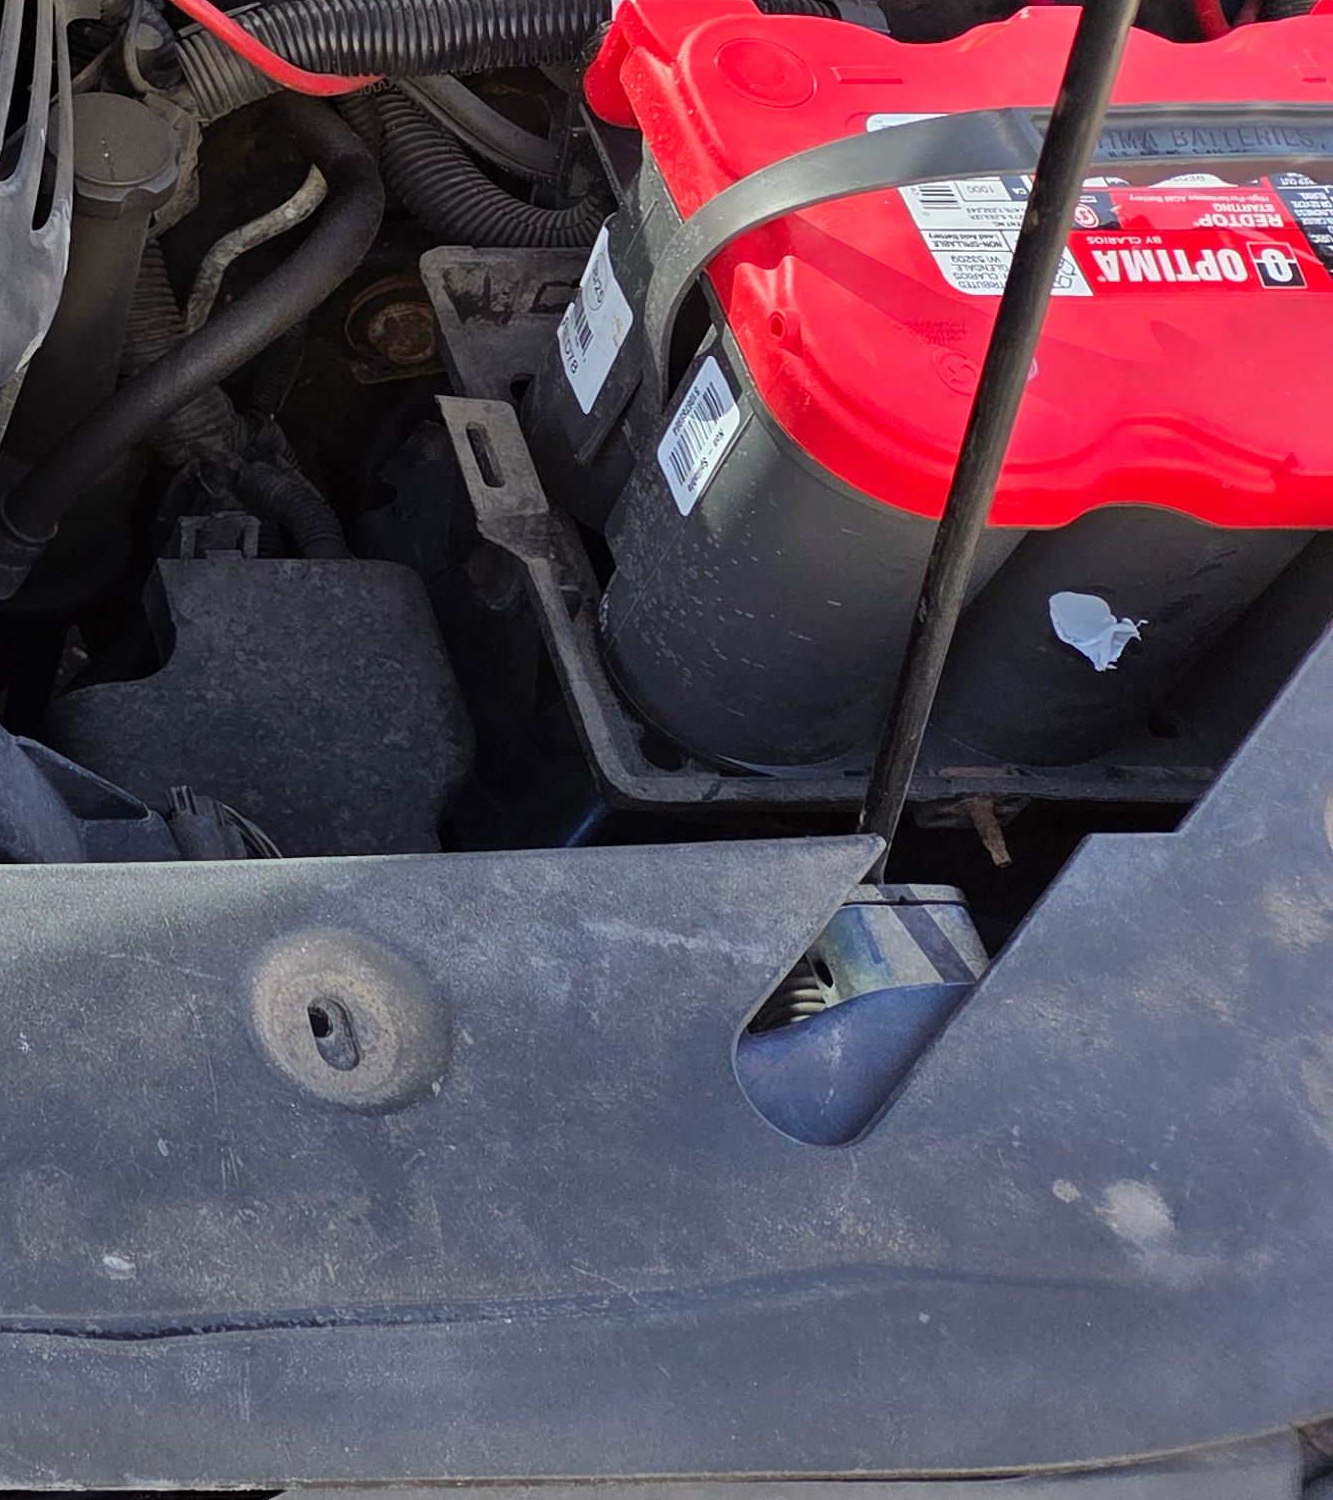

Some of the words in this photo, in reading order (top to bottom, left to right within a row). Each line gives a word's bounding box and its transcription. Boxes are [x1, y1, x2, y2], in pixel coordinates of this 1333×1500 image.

[1099, 130, 1158, 150] TIMA
[1129, 194, 1164, 203] Battery
[1165, 195, 1188, 203] AGM
[1213, 203, 1275, 213] STARTING
[1086, 236, 1140, 245] CLARIOS
[1143, 236, 1162, 245] BY
[951, 255, 983, 263] 53209
[953, 272, 998, 280] CLARIOS
[958, 281, 1004, 289] TRIBUTED
